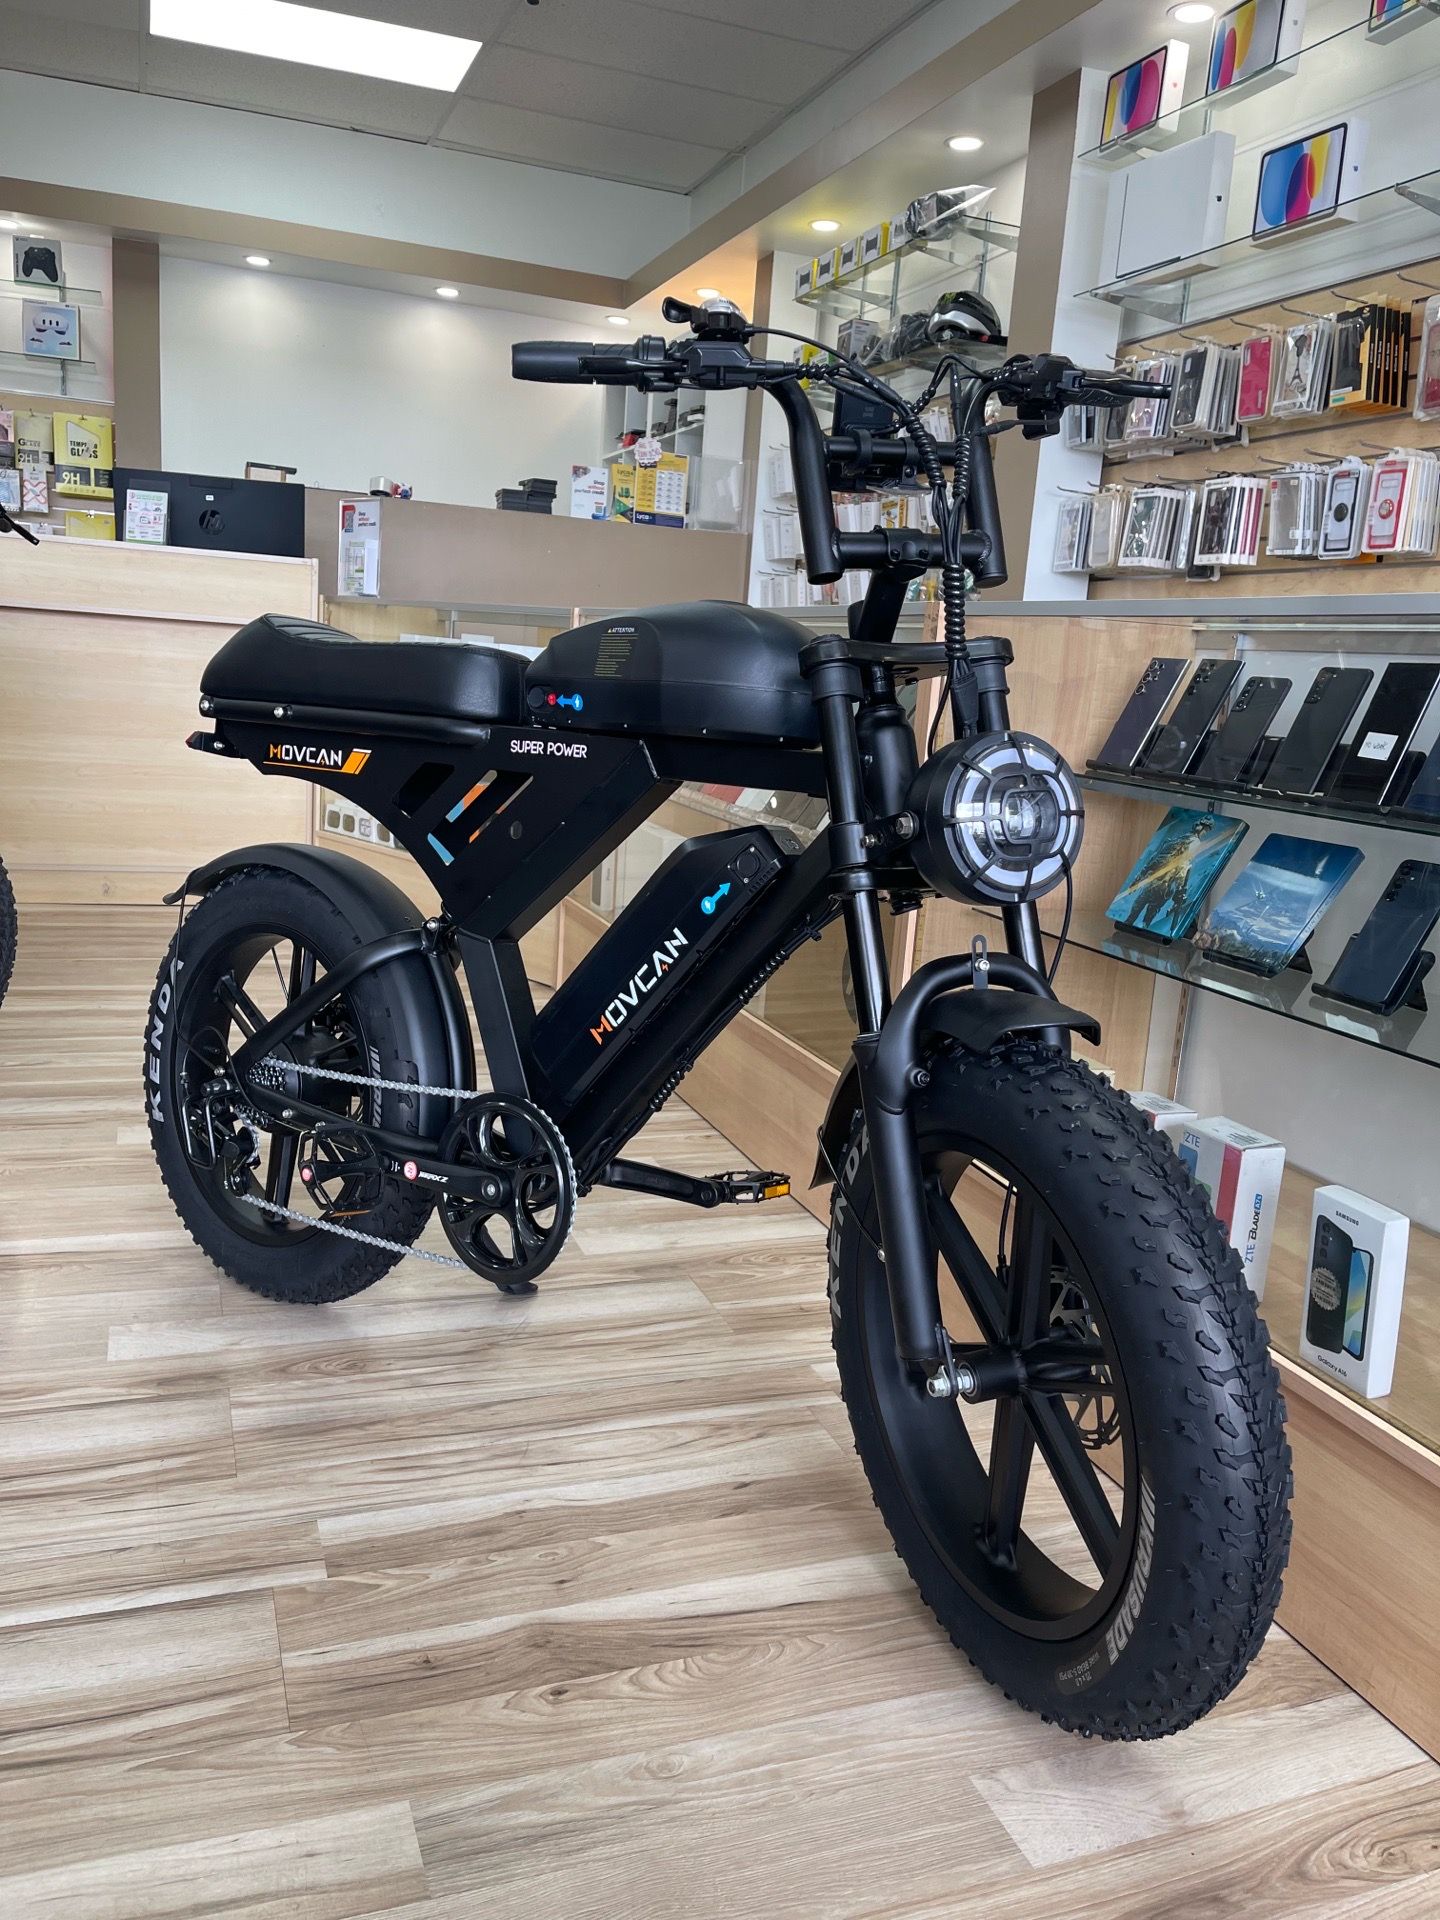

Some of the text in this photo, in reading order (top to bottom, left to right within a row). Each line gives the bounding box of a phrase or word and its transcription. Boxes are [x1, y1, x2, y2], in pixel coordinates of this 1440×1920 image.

[62, 472, 80, 486] 9H
[269, 743, 343, 767] MOVCAN
[510, 739, 588, 758] SUPER POWER
[590, 927, 689, 1045] MOVCAN
[149, 957, 185, 1123] KENDA
[1185, 1131, 1200, 1147] ZTE
[1335, 1210, 1359, 1226] SAMSUNG
[1245, 1243, 1256, 1263] ZTE
[1317, 1354, 1338, 1371] Galaxy
